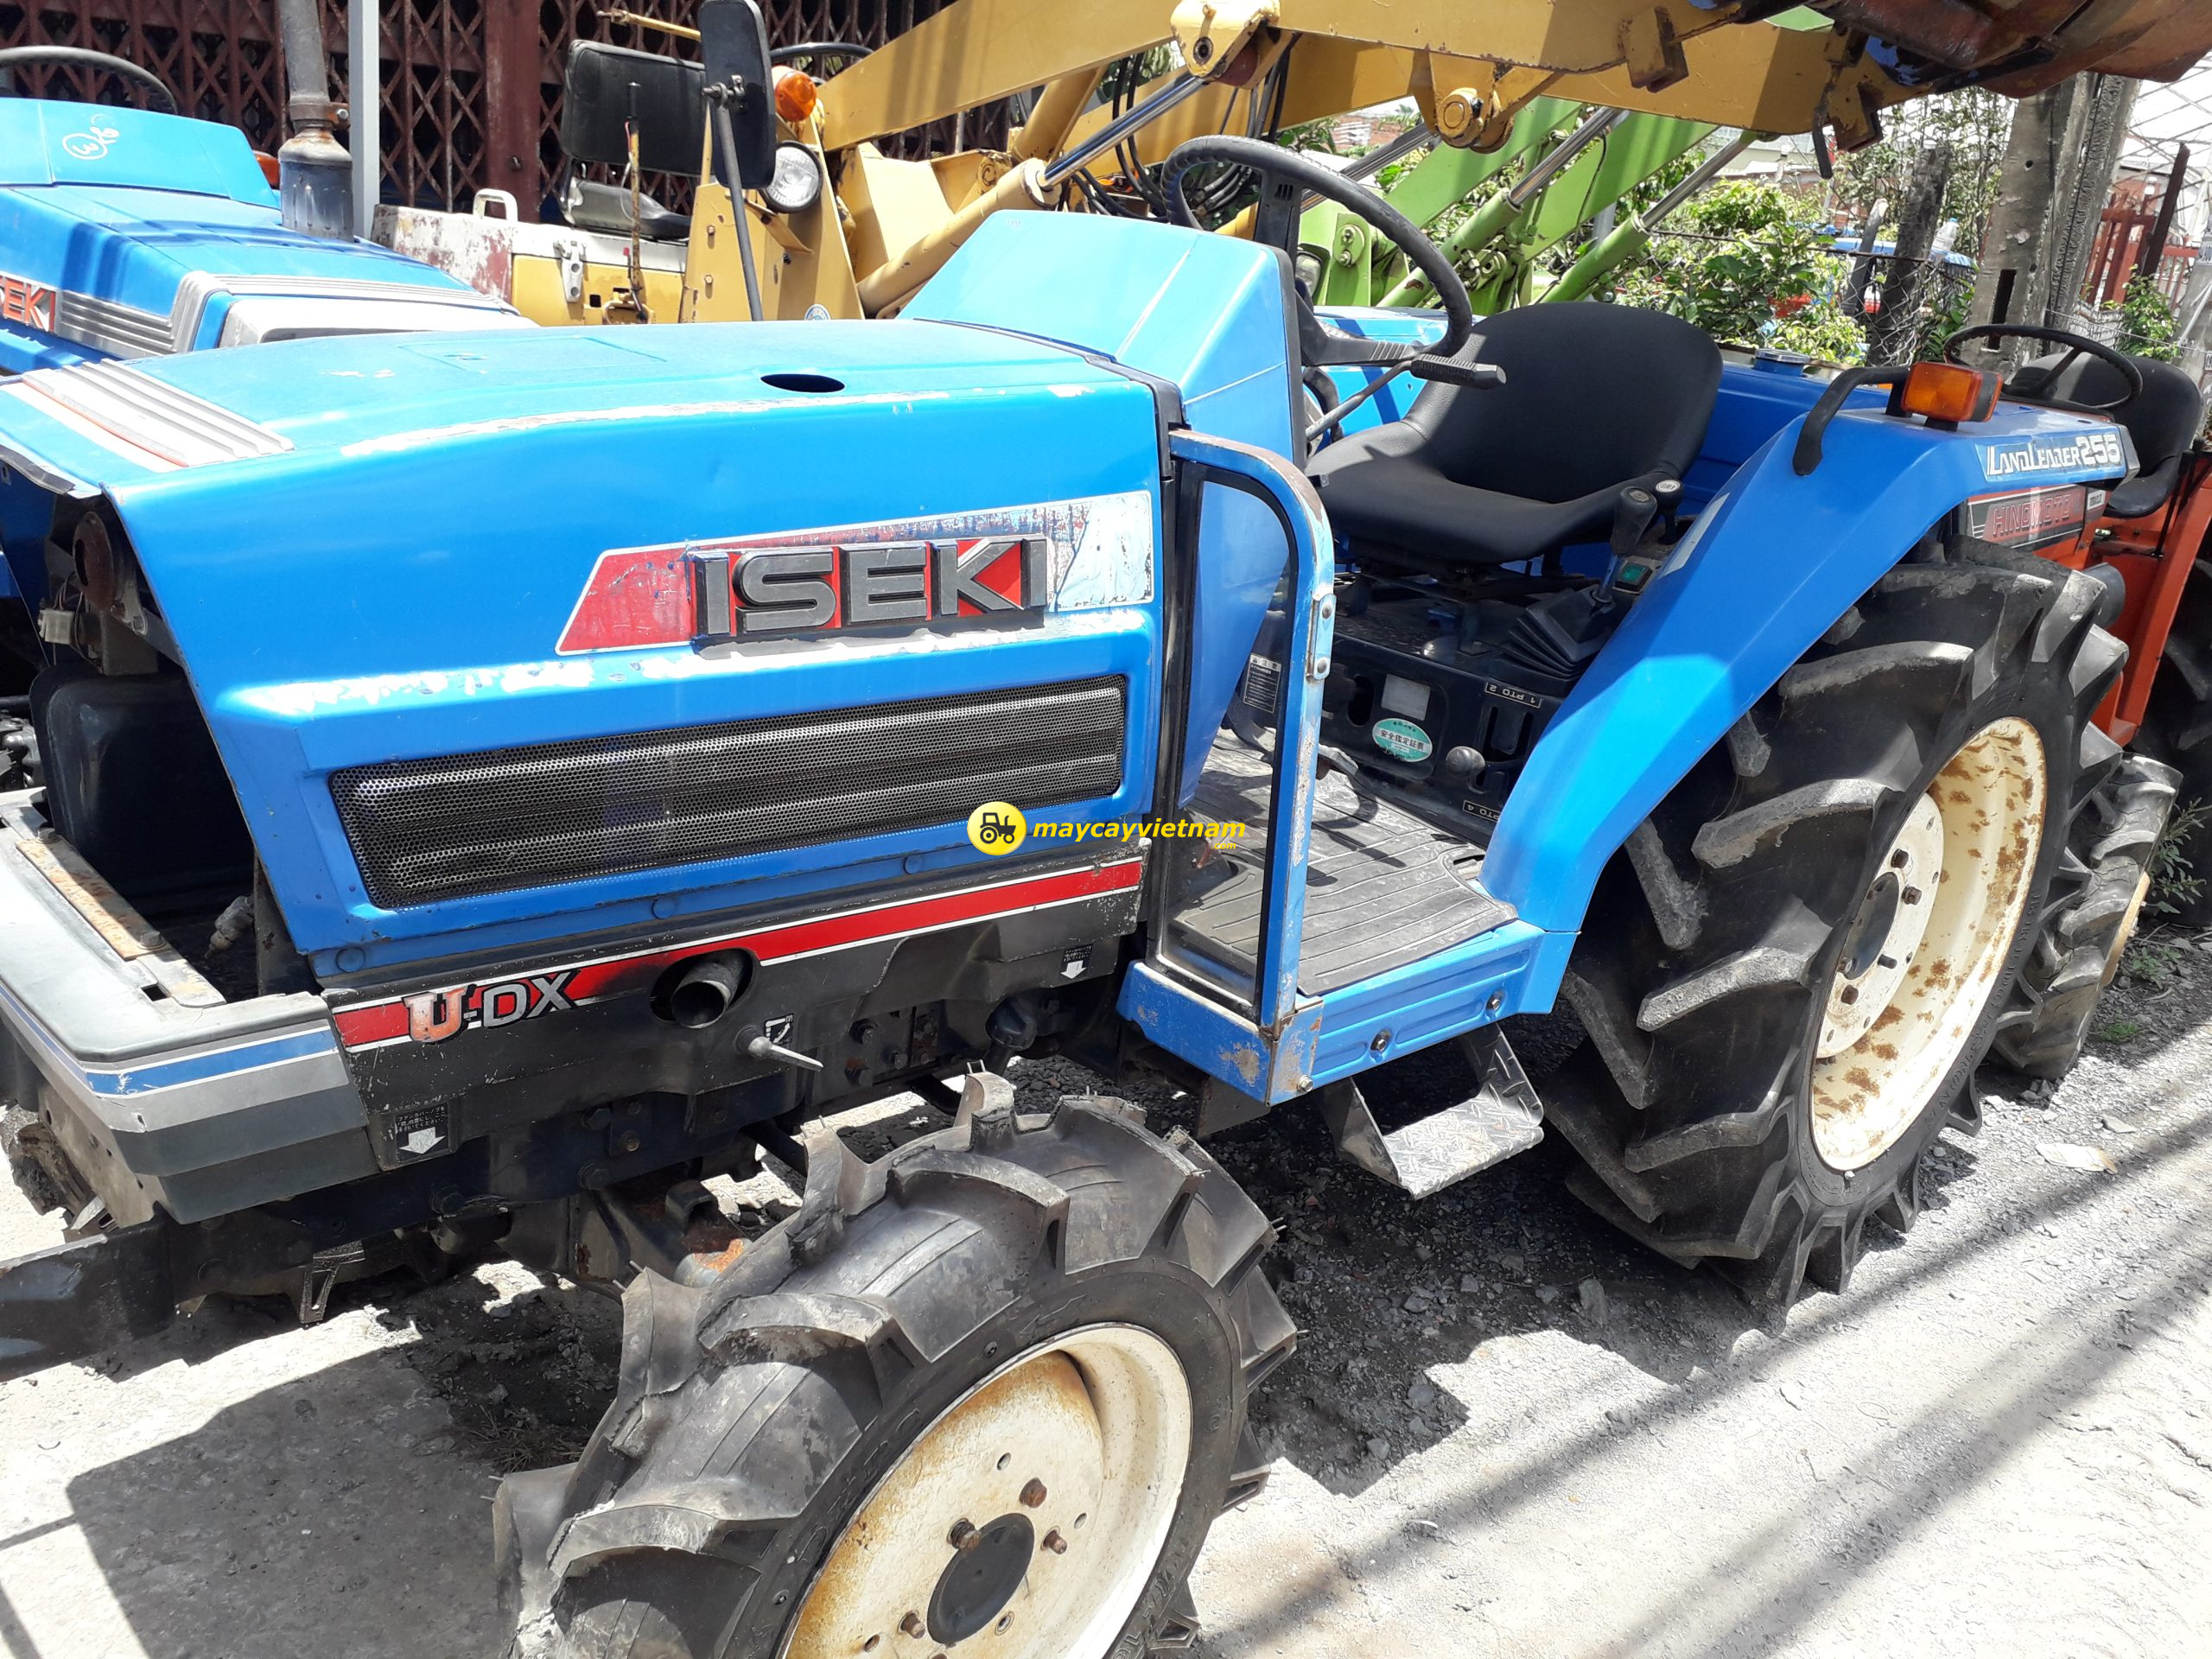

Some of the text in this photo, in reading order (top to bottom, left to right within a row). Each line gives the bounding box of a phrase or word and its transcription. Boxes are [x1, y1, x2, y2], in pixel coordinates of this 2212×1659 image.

[0, 276, 57, 334] EKI
[1993, 494, 2071, 537] HINOMOTO
[695, 536, 1047, 637] ISEKI
[1489, 683, 1497, 692] 2
[1502, 688, 1525, 701] PTO
[402, 969, 574, 1043] U-DX
